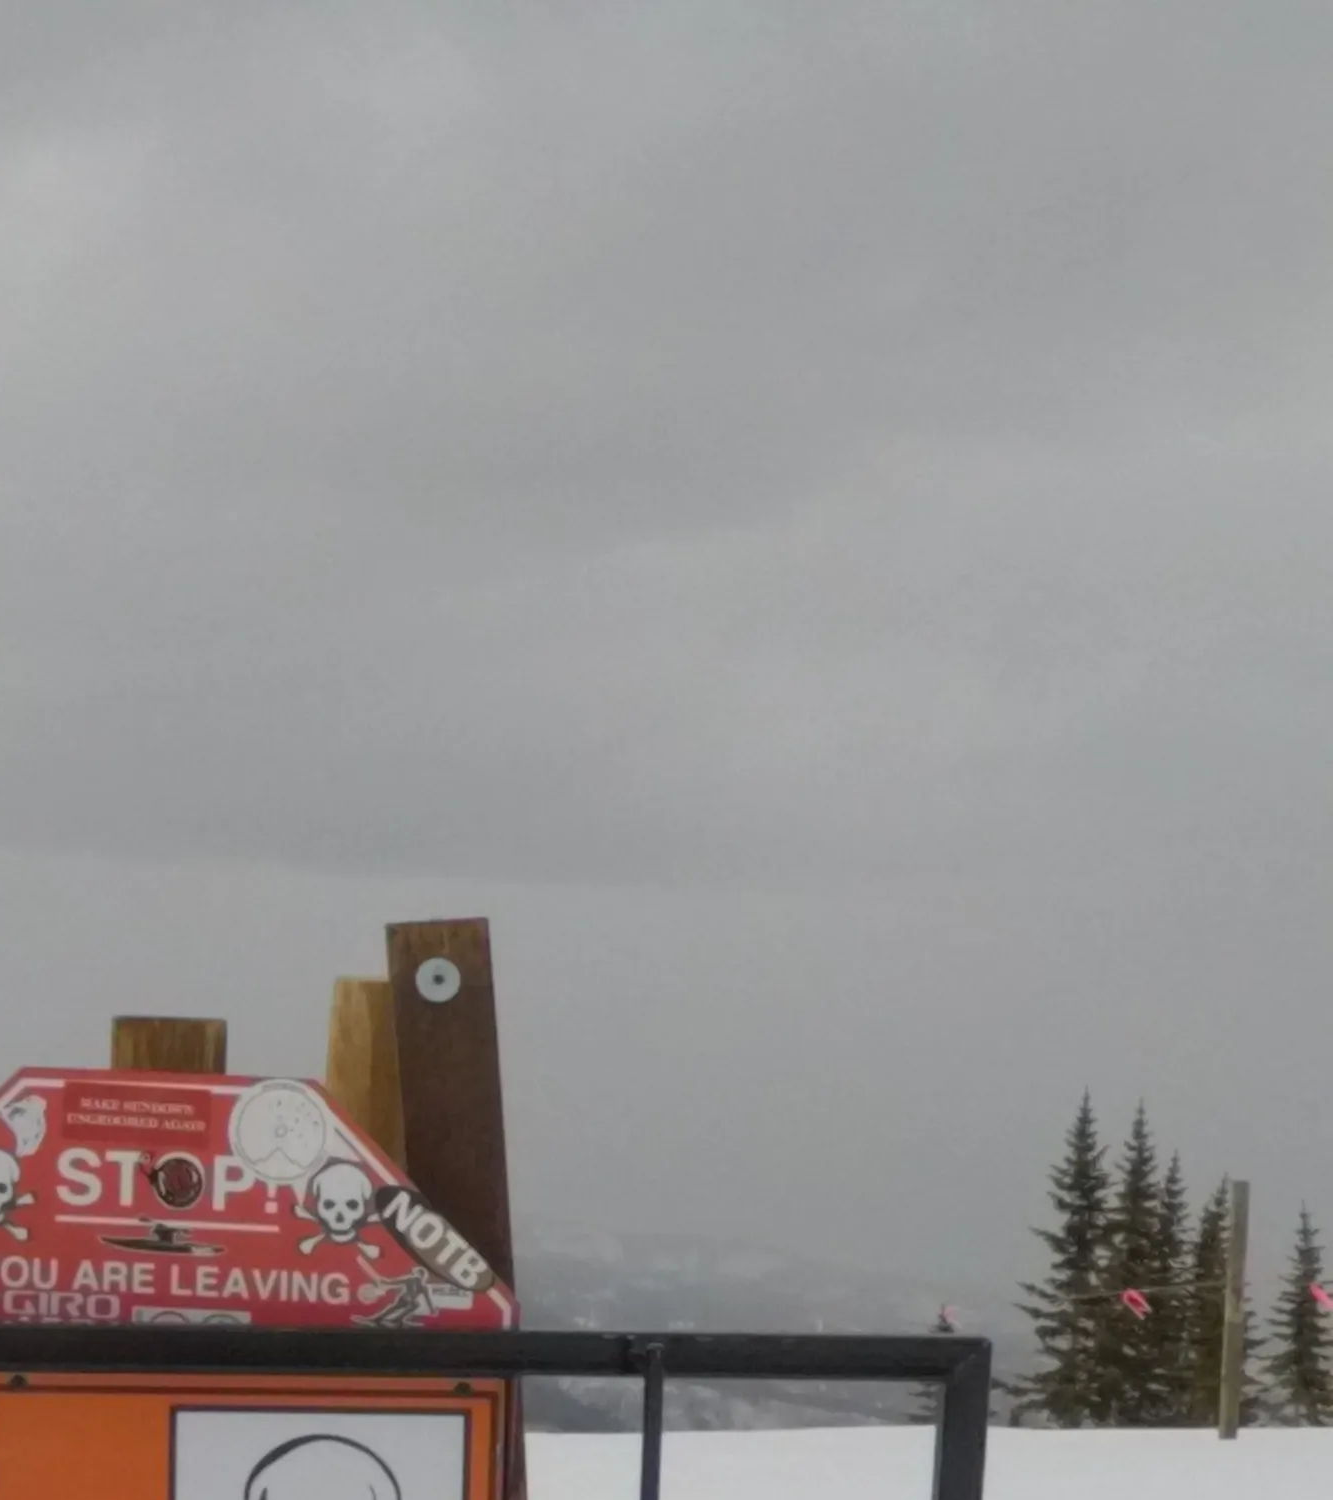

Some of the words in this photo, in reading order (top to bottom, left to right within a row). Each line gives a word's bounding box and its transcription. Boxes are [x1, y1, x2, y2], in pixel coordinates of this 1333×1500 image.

[381, 1189, 490, 1290] NOTB
[2, 1288, 121, 1320] GIRO
[71, 1260, 155, 1297] ARE
[171, 1264, 351, 1306] LEAVING
